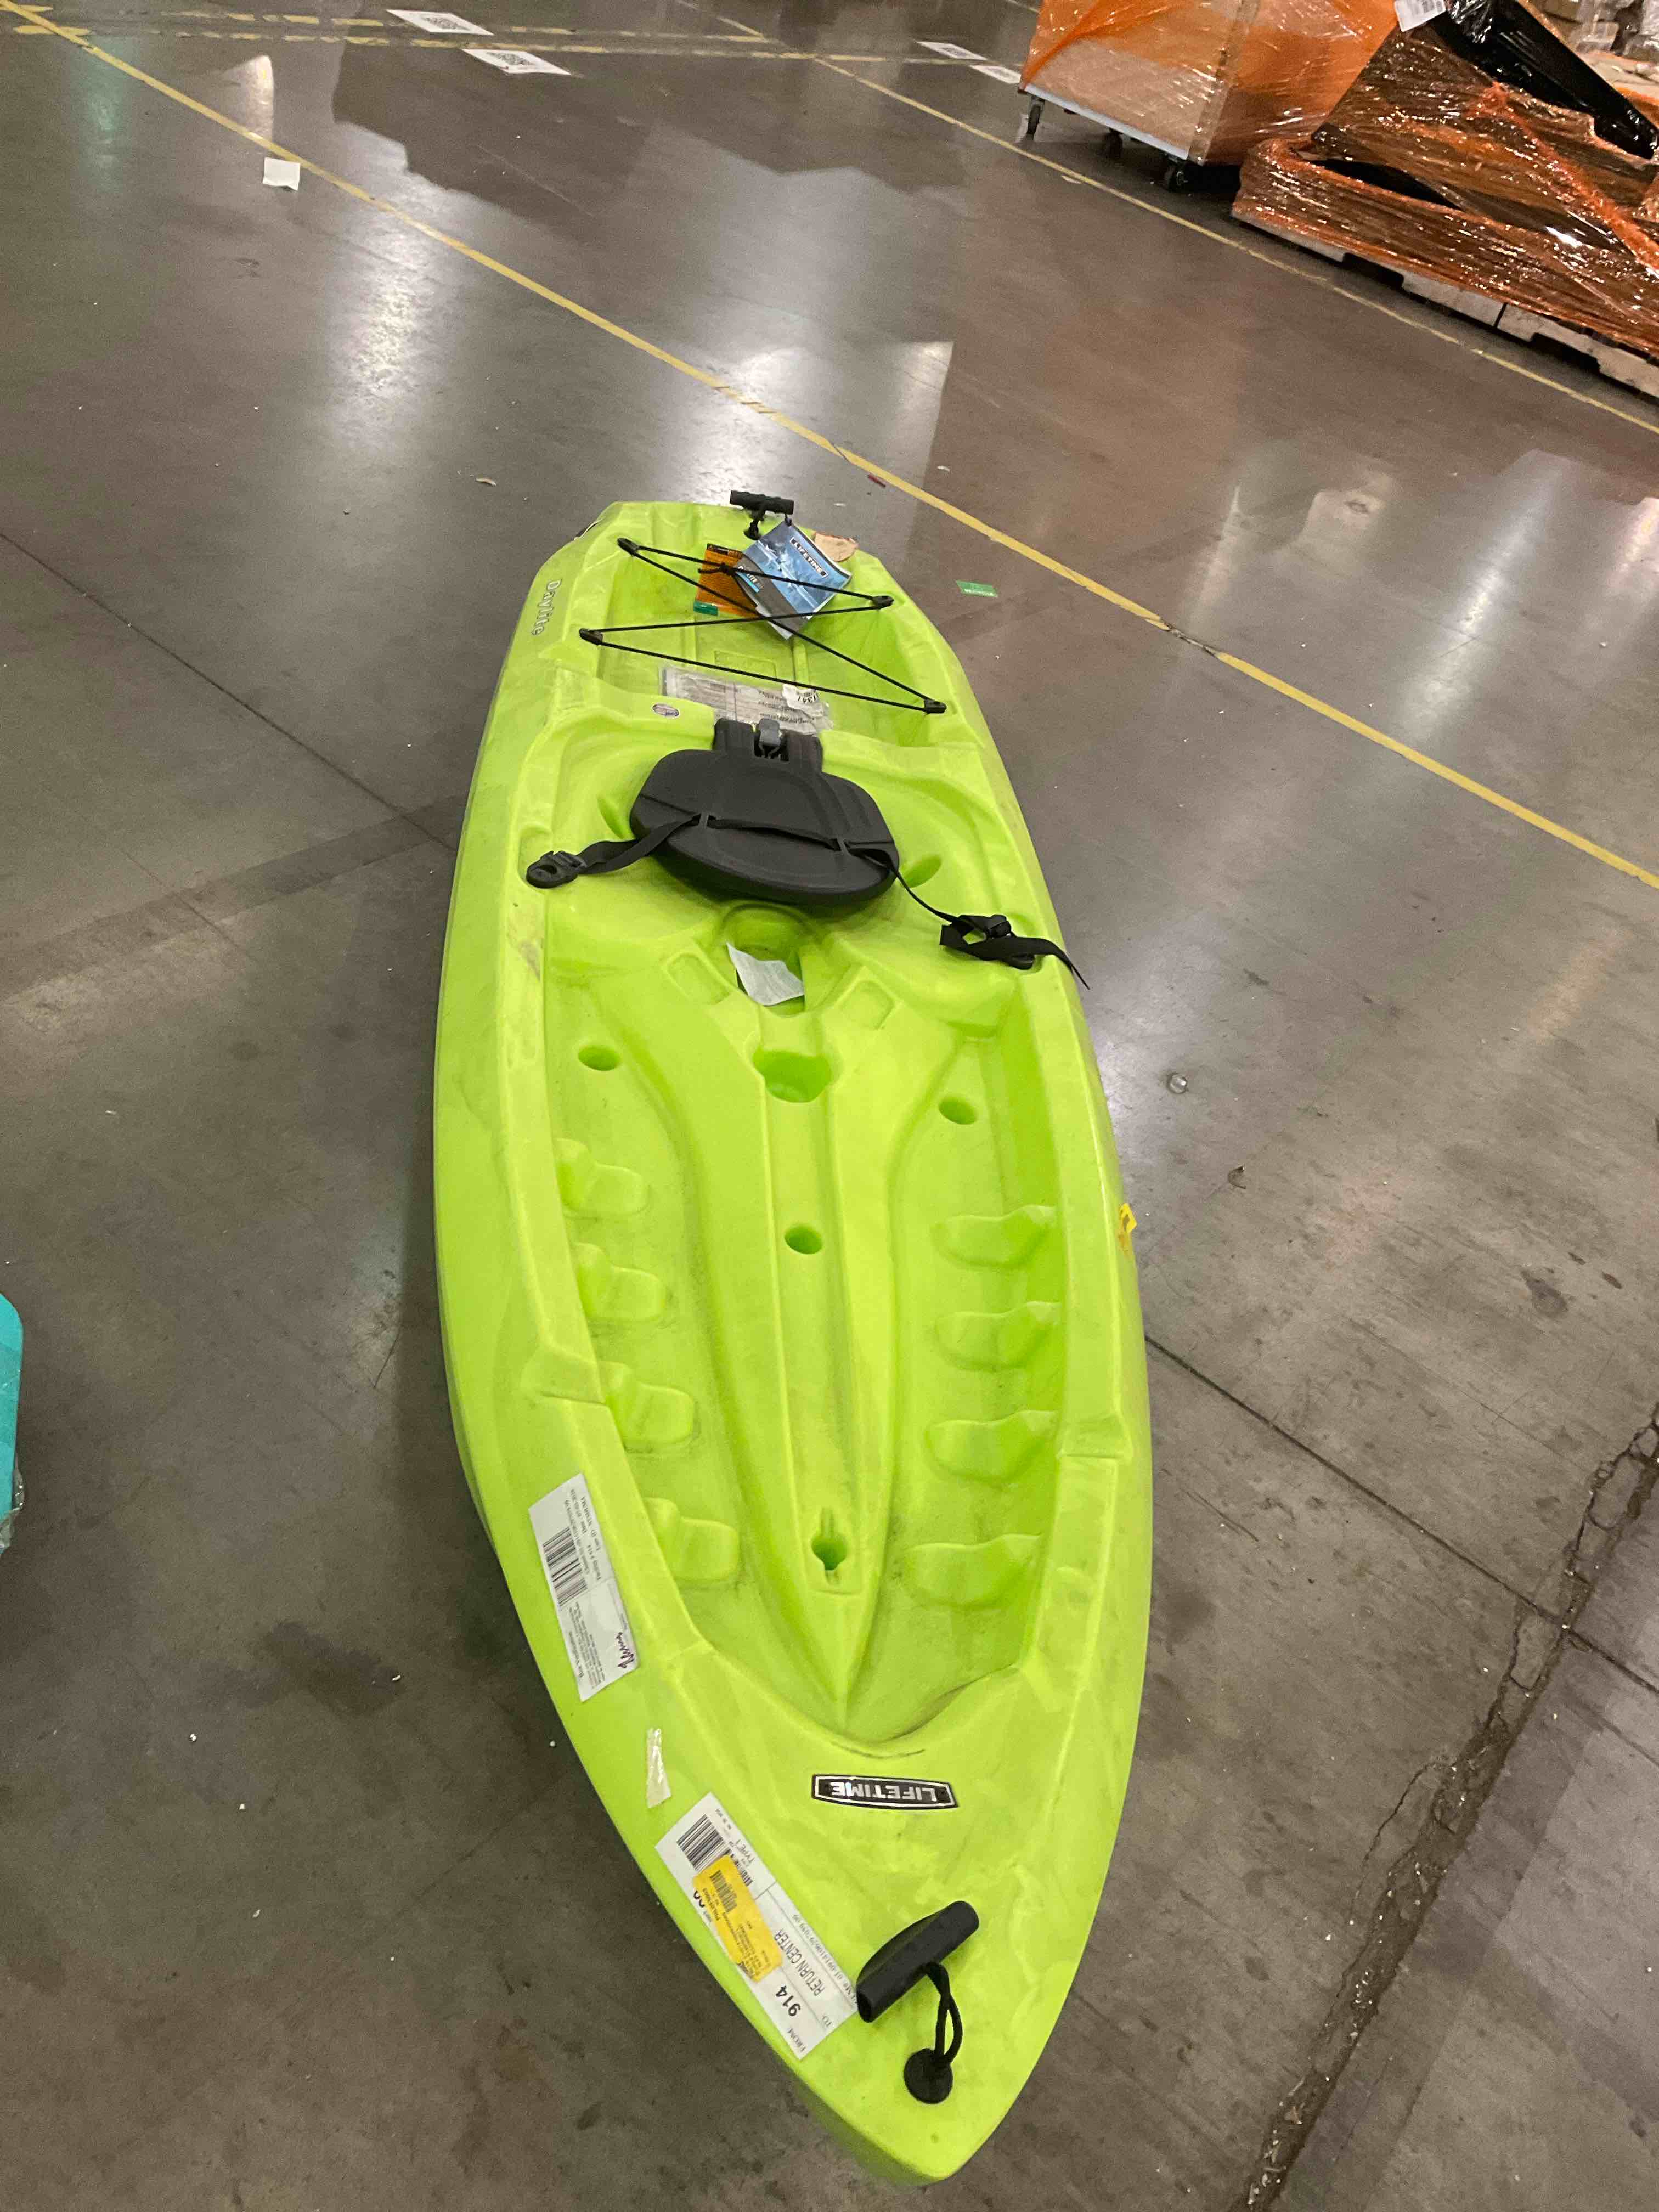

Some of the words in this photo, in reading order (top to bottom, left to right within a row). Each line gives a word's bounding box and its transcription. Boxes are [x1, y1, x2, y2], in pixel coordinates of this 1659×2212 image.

[793, 542, 823, 574] LIFETIME
[532, 579, 562, 636] Daylite
[830, 1781, 937, 1802] LIFETIME
[772, 1928, 803, 1965] CENTER
[794, 1959, 826, 1996] RETURN
[774, 1984, 802, 2018] 914
